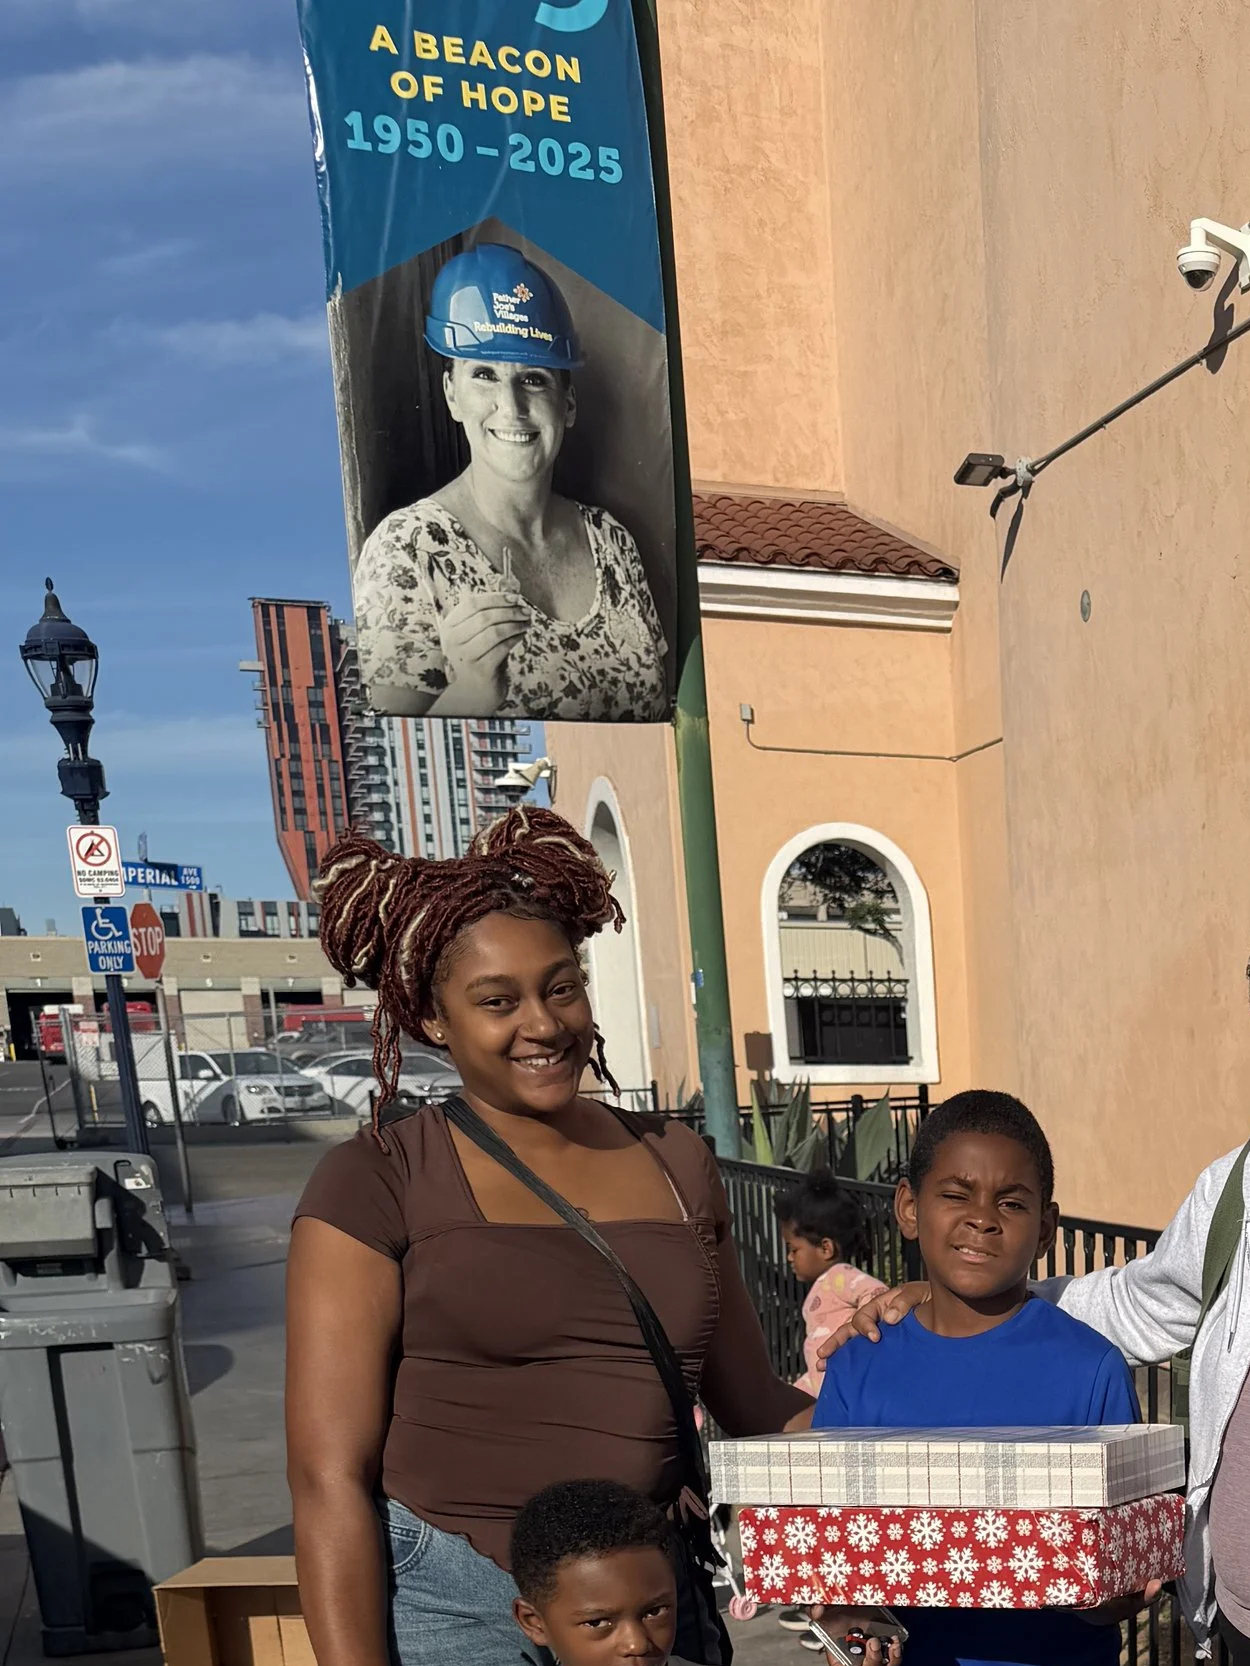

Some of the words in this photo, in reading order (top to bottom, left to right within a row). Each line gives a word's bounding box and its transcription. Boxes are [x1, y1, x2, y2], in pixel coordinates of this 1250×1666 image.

[369, 24, 399, 56] A
[413, 30, 582, 84] BEACON
[390, 70, 444, 102] OF
[461, 82, 572, 123] HOPE
[343, 110, 464, 163] 1950
[508, 133, 624, 185] 2025
[492, 292, 520, 304] Father
[494, 309, 529, 323] Villages
[473, 321, 529, 339] Rebuilding
[529, 327, 553, 342] Lives
[182, 868, 198, 876] AVE
[88, 940, 131, 955] PARKING
[131, 927, 162, 957] STOP
[98, 956, 124, 970] ONLY
